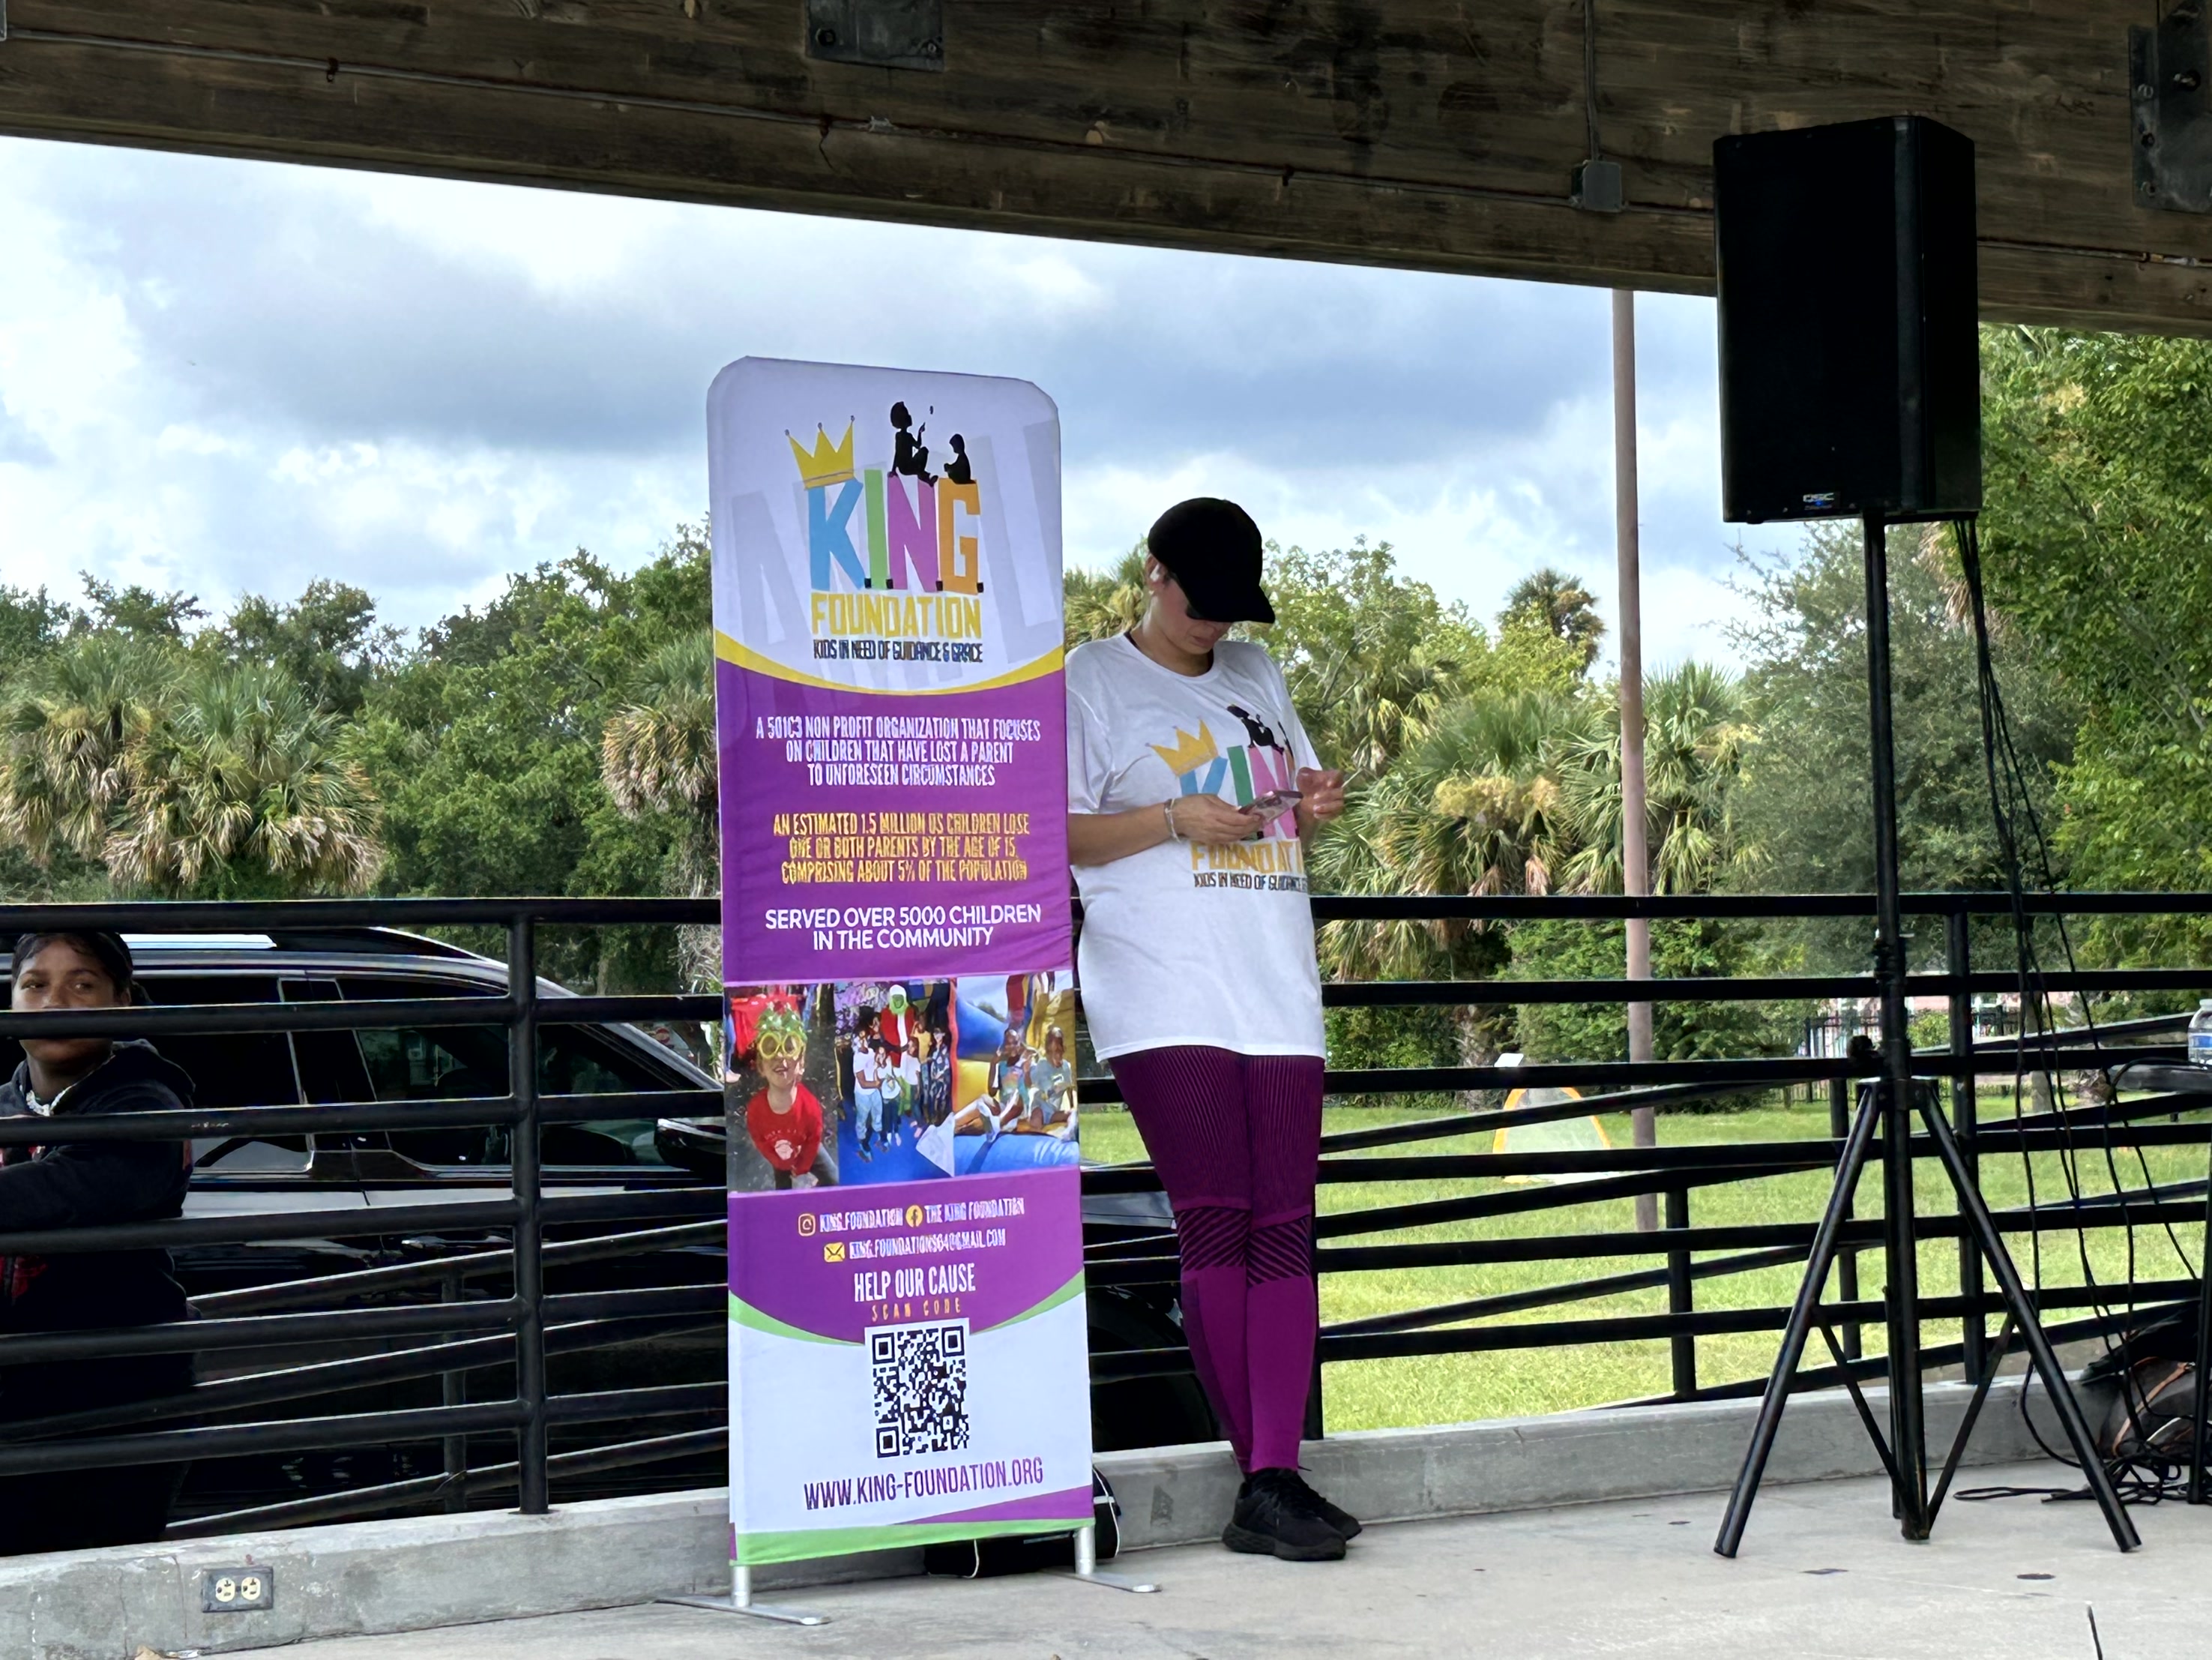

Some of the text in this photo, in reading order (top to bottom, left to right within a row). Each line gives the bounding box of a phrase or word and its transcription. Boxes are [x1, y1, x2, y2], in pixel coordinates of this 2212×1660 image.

[811, 593, 982, 639] FOUNDATION
[813, 640, 837, 659] KIDS
[839, 640, 849, 659] IN
[852, 640, 876, 660] NEED
[878, 640, 890, 660] OF
[892, 641, 941, 662] GUIDANCE
[951, 643, 983, 663] GRACE
[756, 716, 765, 739] A
[805, 715, 831, 739] NON
[834, 715, 873, 739] PROFIT
[876, 716, 959, 740] ORGANIZATION
[961, 718, 990, 740] THAT
[993, 718, 1040, 742] FOCUSES
[786, 739, 1013, 764] ON CHILDREN THAT HAVE LOST A PARENT
[807, 763, 995, 787] TO UNFORESEEN CIRCUMSTANCES
[774, 812, 1030, 836] AN ESTIMATED 1.5 MILLION US CHILDREN LOSE
[789, 836, 813, 858] ONE
[816, 836, 831, 858] OR
[834, 836, 864, 858] BOTH
[867, 835, 918, 858] PARENTS
[922, 836, 936, 858] BY
[938, 836, 960, 858] THE
[963, 836, 984, 858] AGE
[988, 836, 1001, 858] OF
[781, 859, 1028, 884] COMPRISING ABOUT 5% OF THE POPULATION
[1218, 872, 1228, 888] IN
[1254, 874, 1266, 890] OF
[765, 903, 1042, 930] SERVED OVER 5000 CHILDREN
[813, 926, 994, 951] IN THE COMMUNITY
[924, 1197, 1025, 1224] THE KING FOUNDATION
[854, 1263, 976, 1302] HELP OUR CAUSE
[804, 1456, 1043, 1511] WWW.KING-FOUNDATION.ORG
